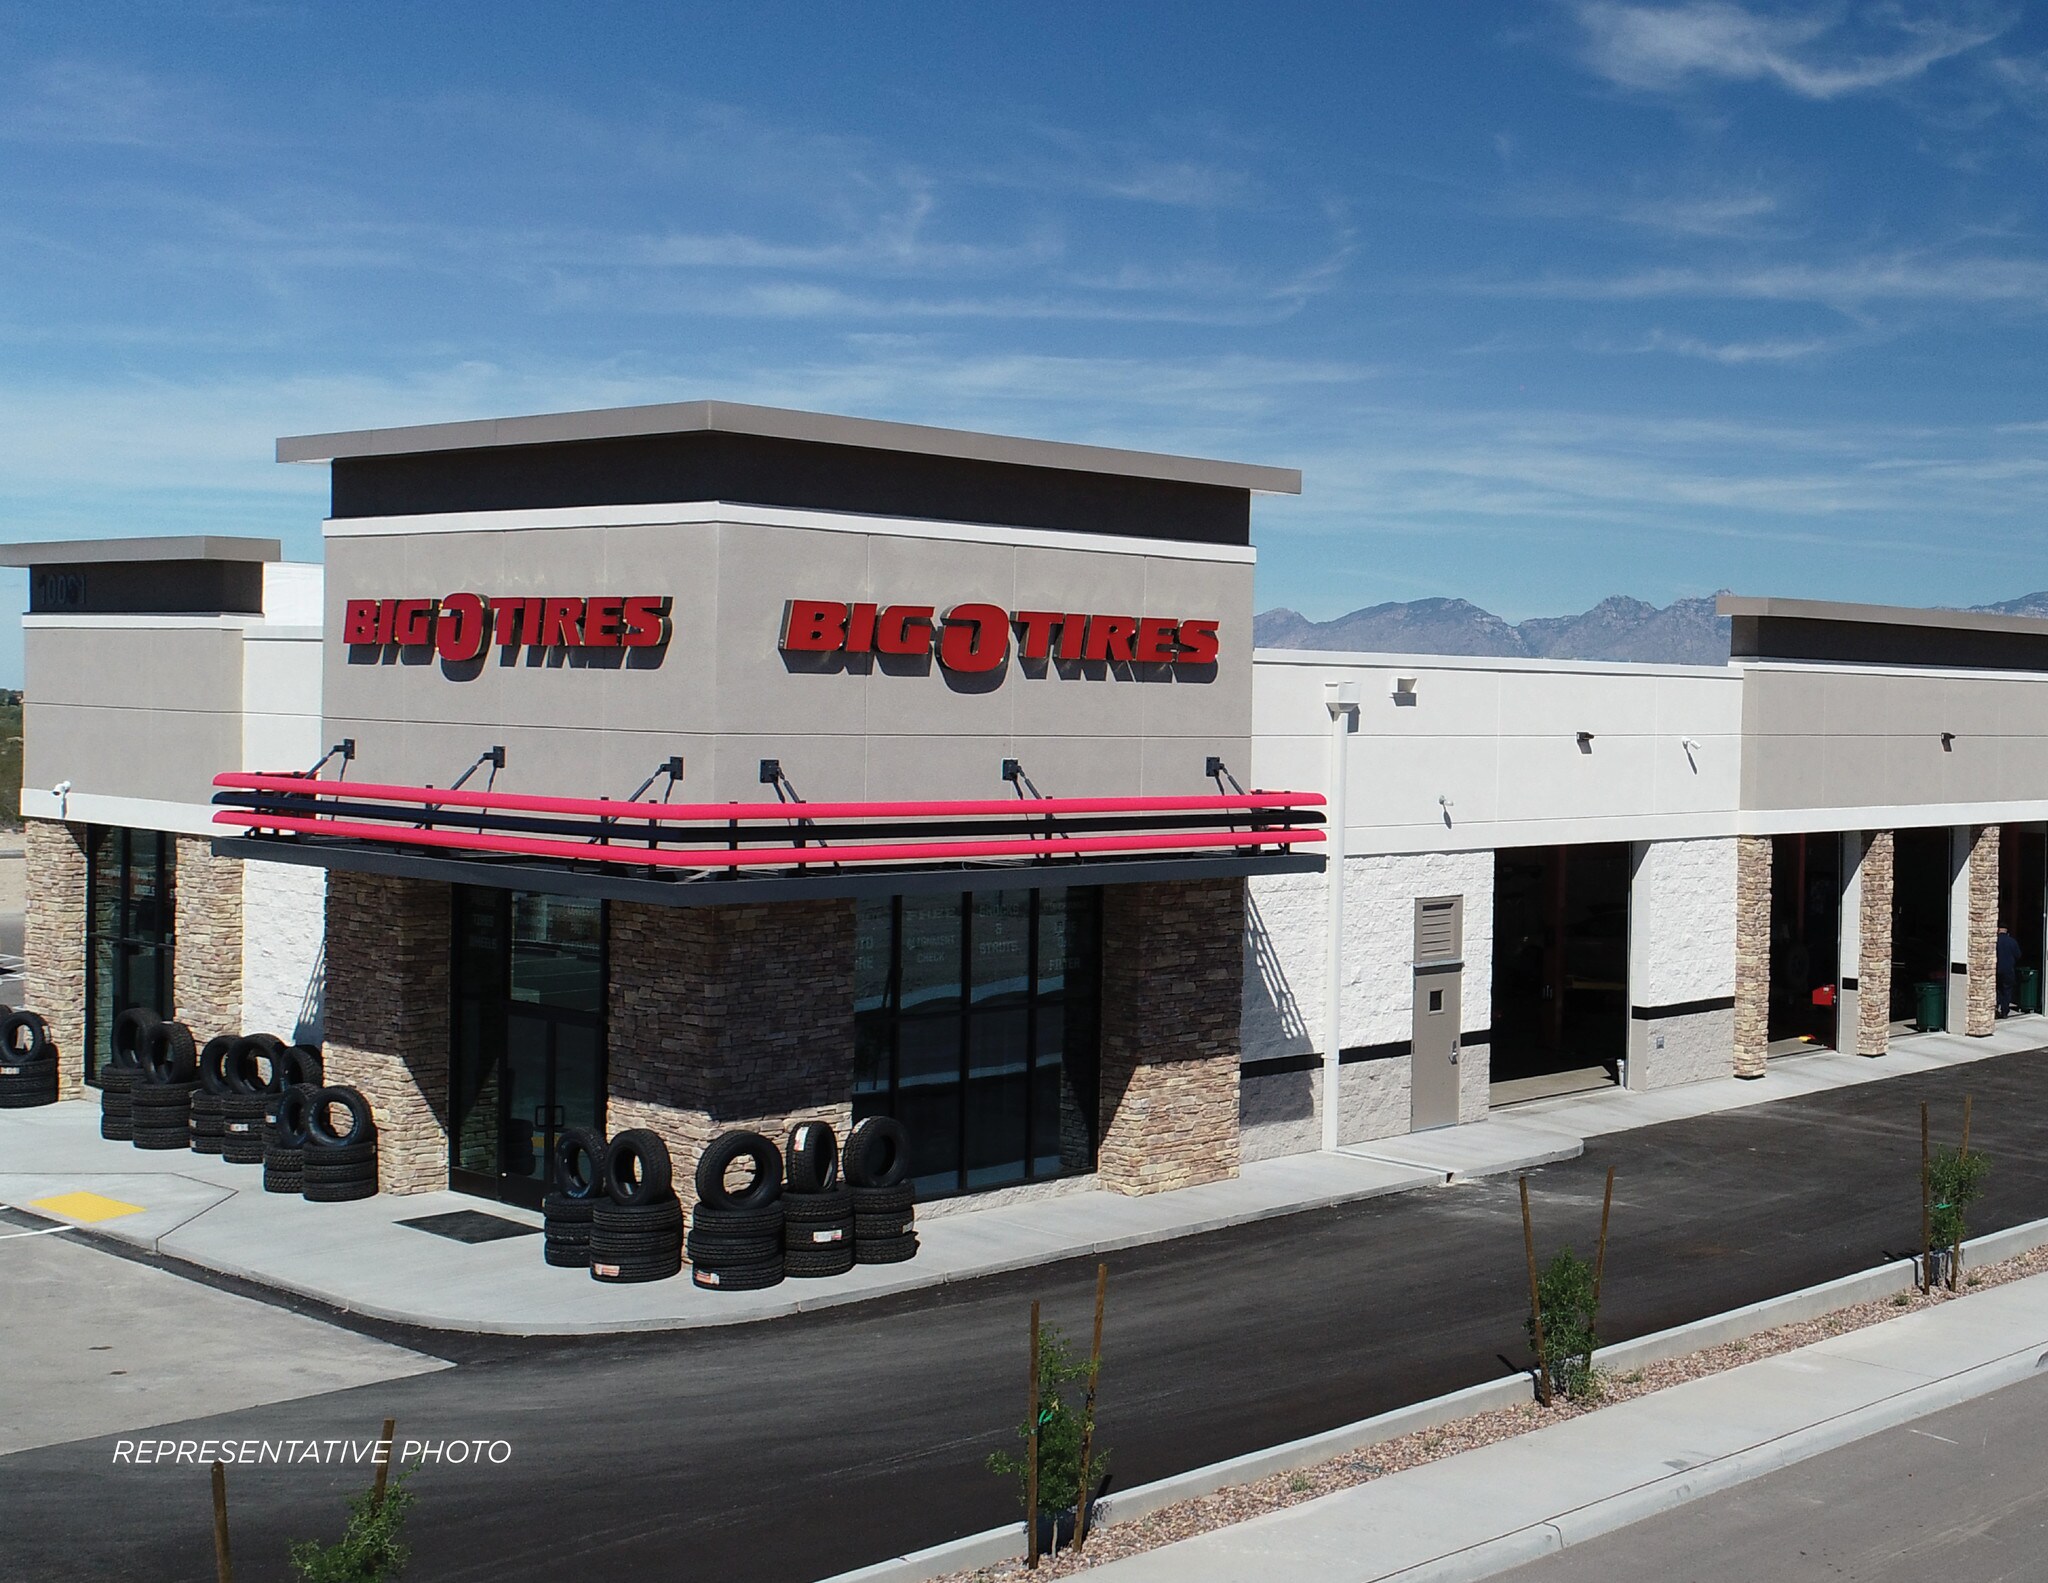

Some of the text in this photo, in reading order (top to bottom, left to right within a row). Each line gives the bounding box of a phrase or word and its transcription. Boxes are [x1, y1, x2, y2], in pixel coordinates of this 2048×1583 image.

[344, 598, 441, 644] BIG
[490, 596, 673, 647] TIRES
[780, 599, 1220, 673] BIG O TIRES
